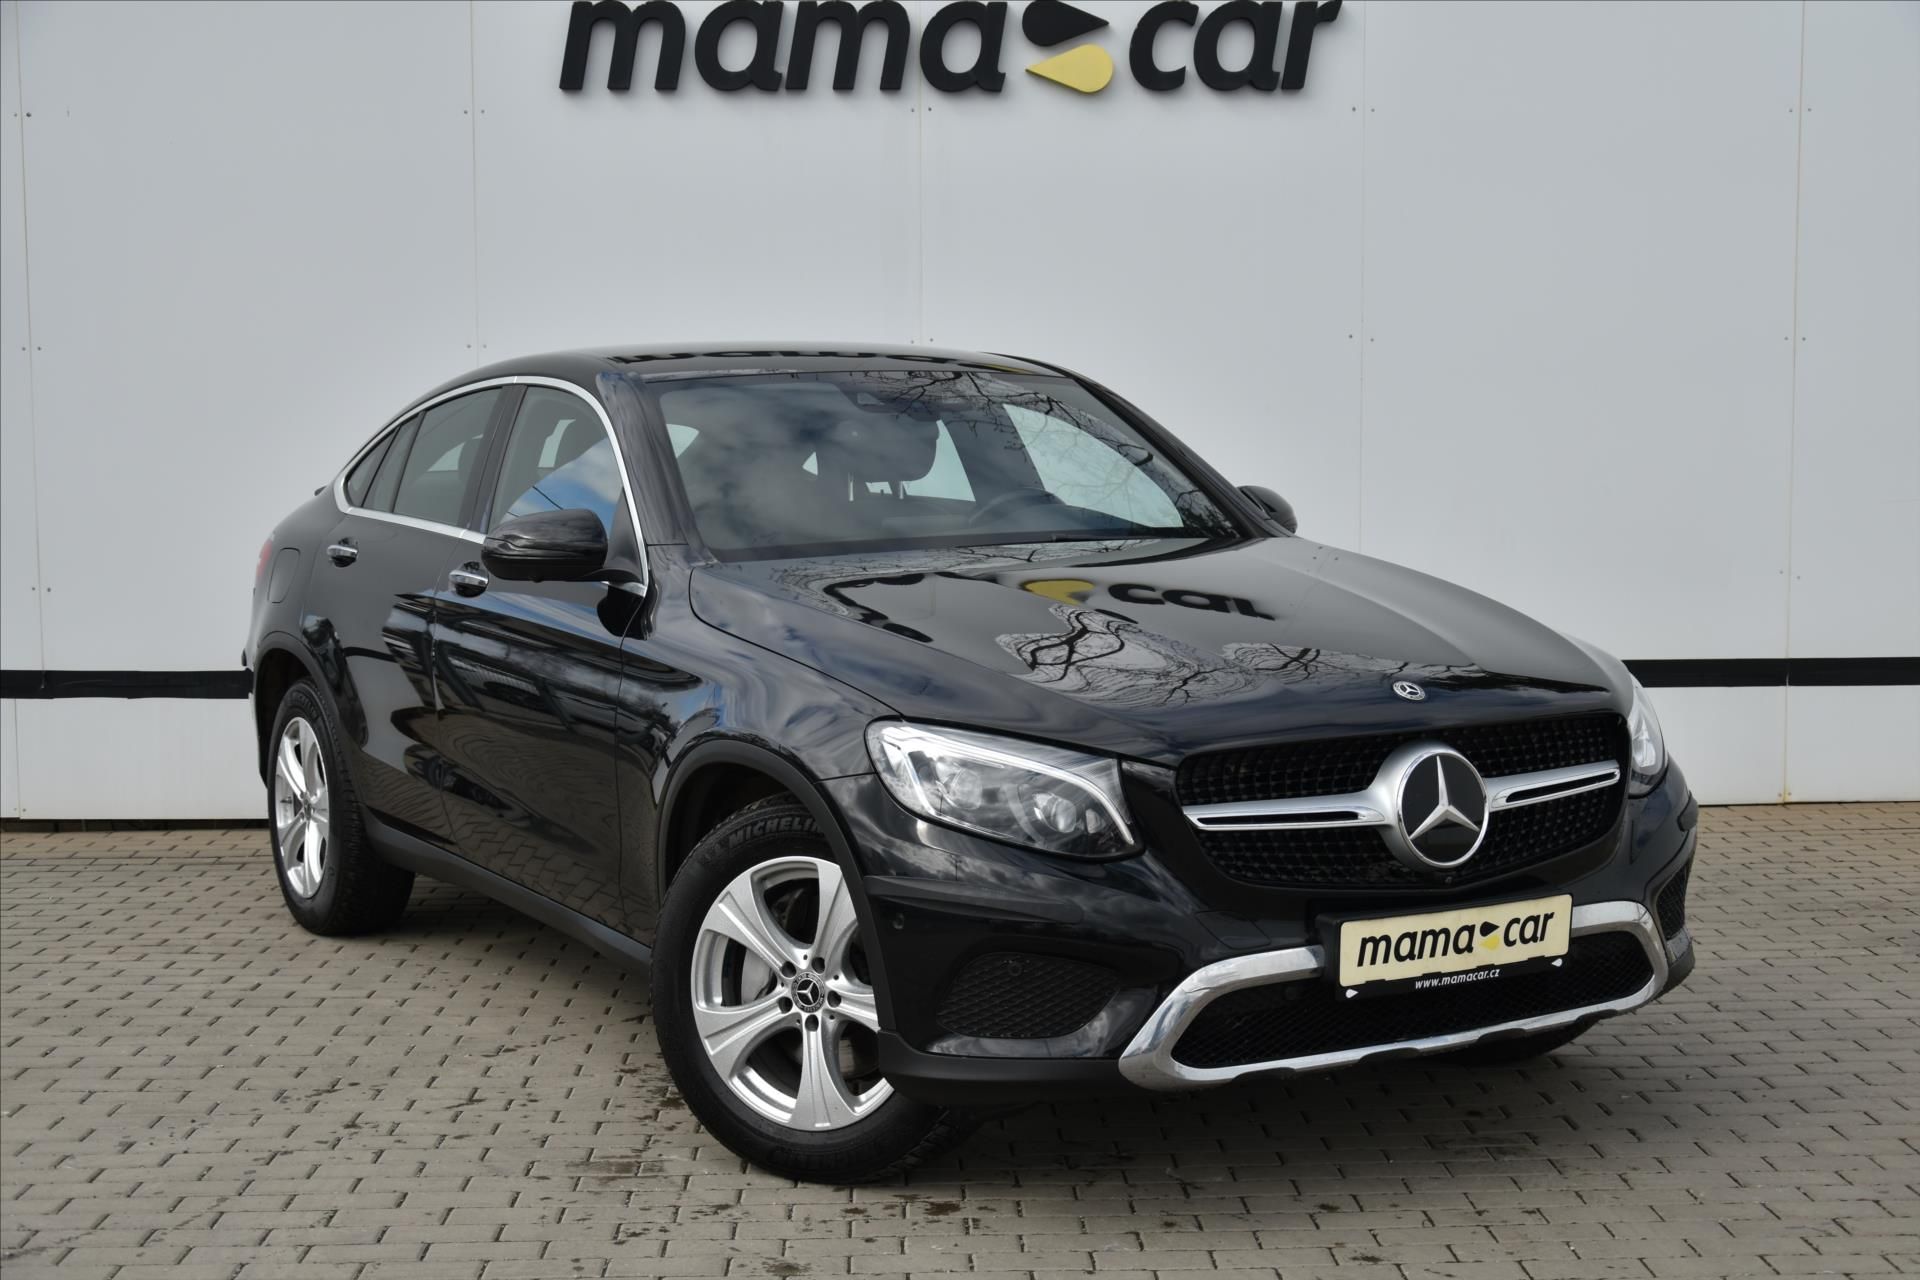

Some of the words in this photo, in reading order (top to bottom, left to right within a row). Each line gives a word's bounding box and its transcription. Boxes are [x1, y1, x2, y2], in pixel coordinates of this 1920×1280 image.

[559, 0, 1006, 92] mama
[1129, 0, 1343, 92] car
[1357, 923, 1476, 967] mama
[1503, 912, 1555, 947] car
[1414, 968, 1501, 990] www.mamacar.cz
